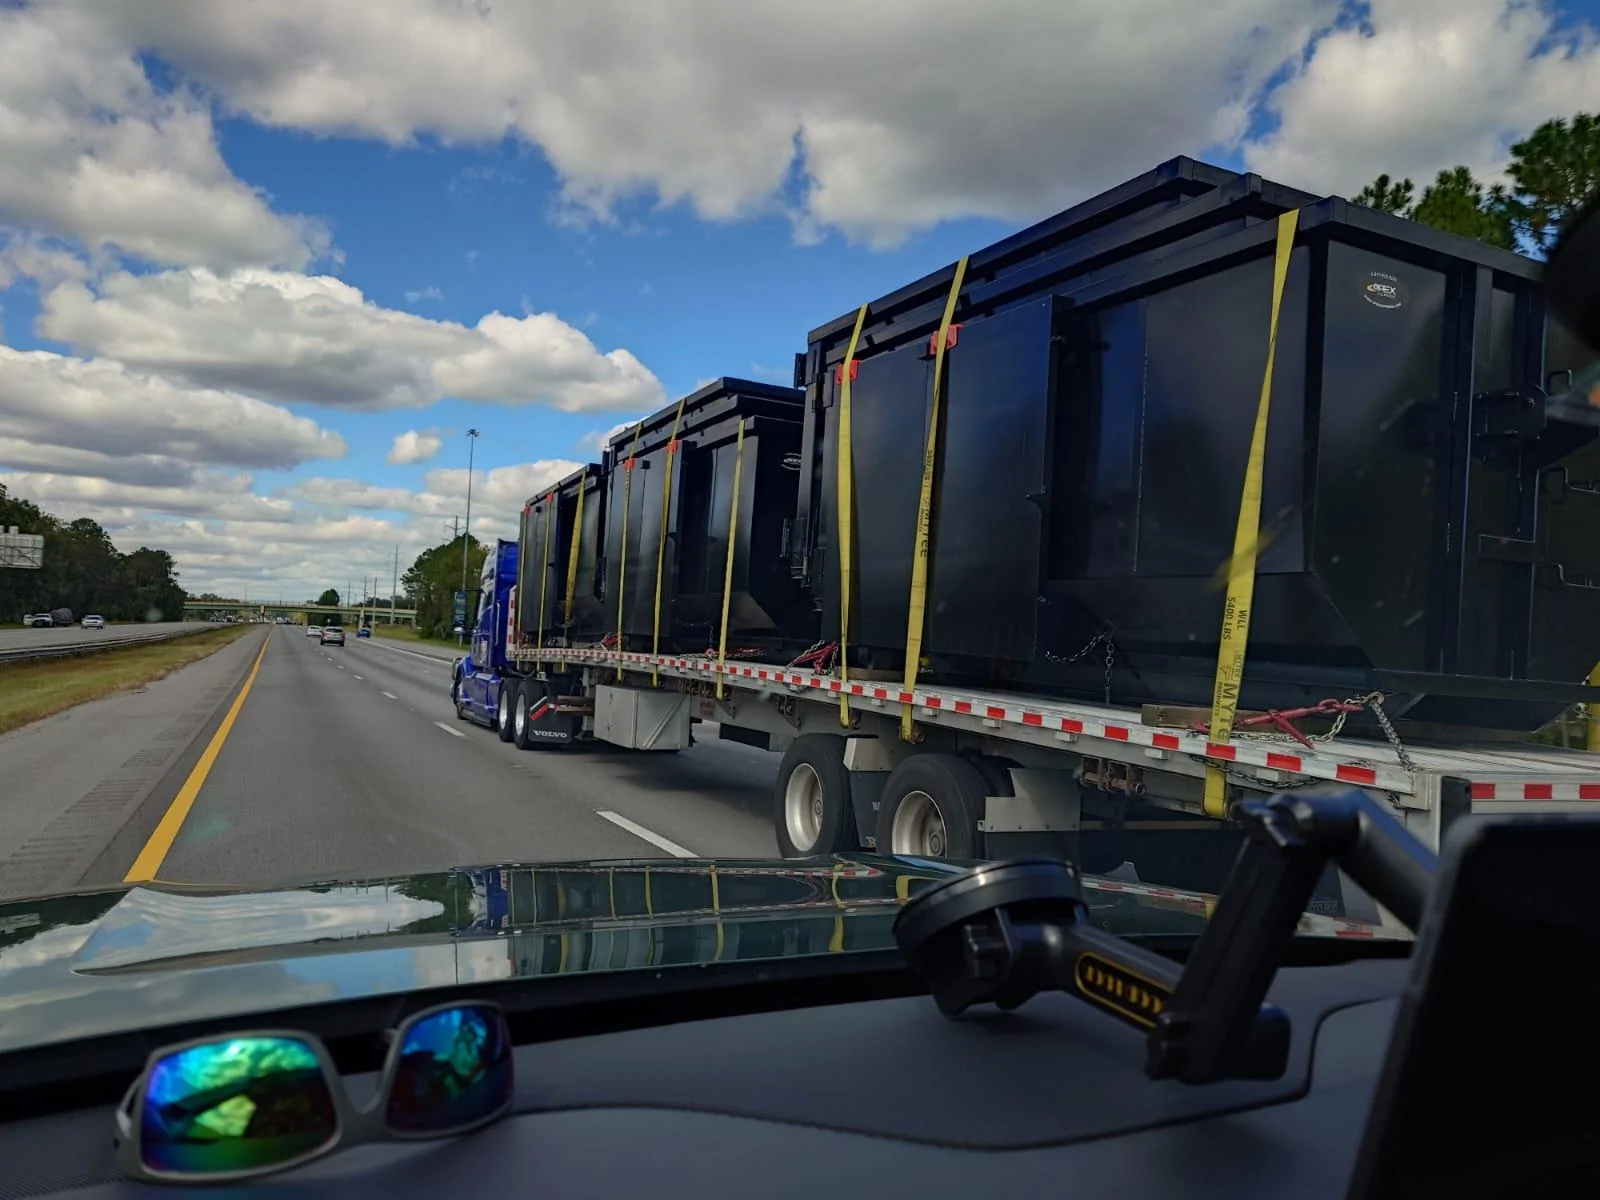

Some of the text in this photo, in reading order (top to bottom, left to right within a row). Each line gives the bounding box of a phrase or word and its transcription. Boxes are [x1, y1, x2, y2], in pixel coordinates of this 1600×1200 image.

[1223, 596, 1237, 641] 5400 LBS
[1236, 609, 1248, 630] WLL
[532, 729, 568, 738] VOLVO
